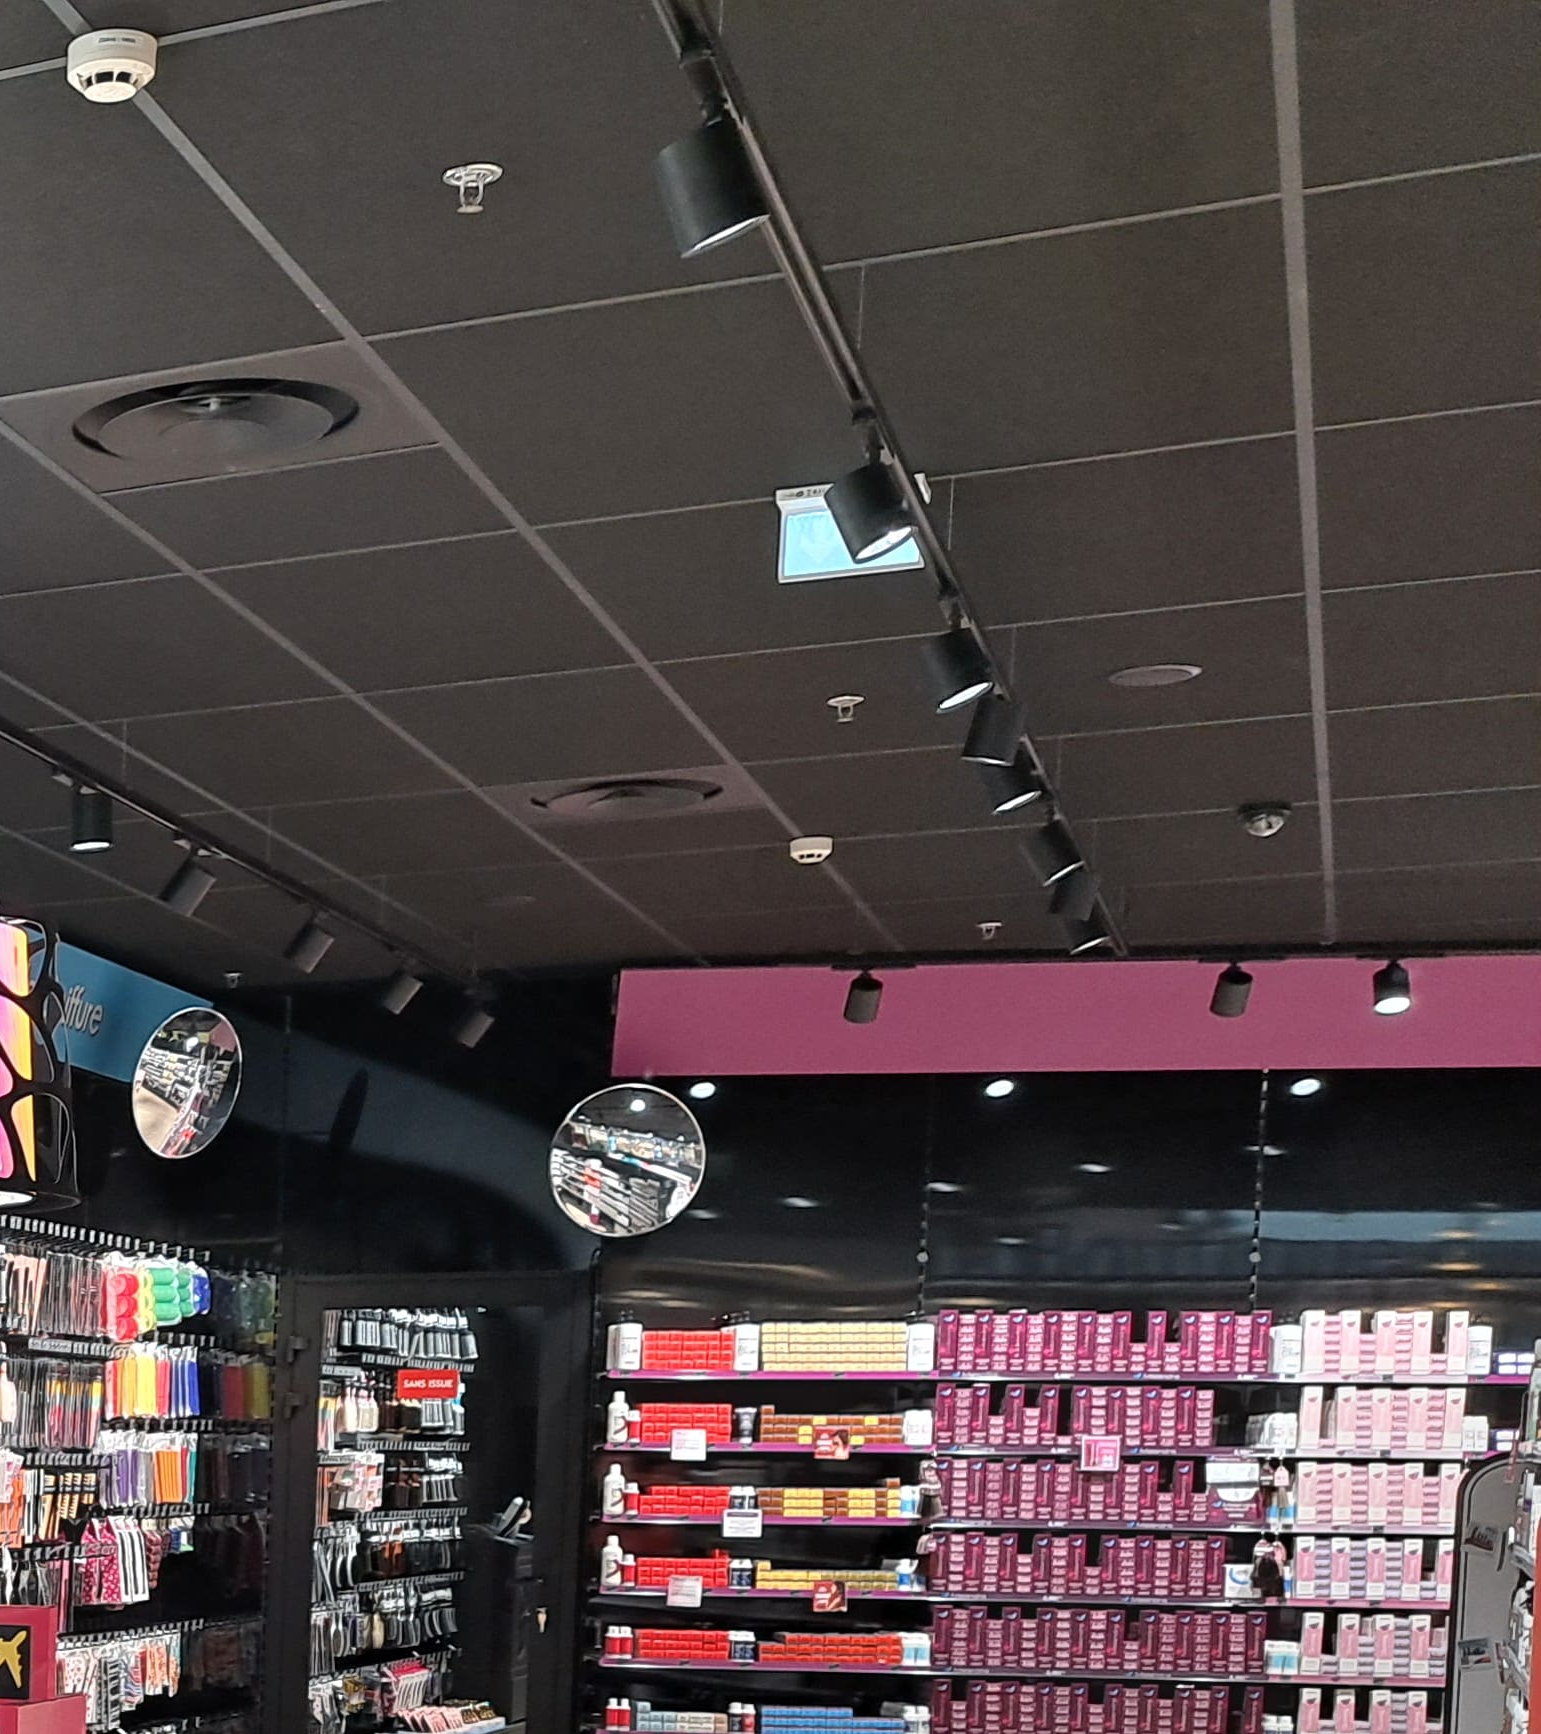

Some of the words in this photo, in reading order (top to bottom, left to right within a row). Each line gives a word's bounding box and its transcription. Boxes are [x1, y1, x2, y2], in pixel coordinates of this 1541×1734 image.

[67, 985, 104, 1036] iffure
[404, 1379, 426, 1389] SANS
[428, 1379, 454, 1389] ISSUE
